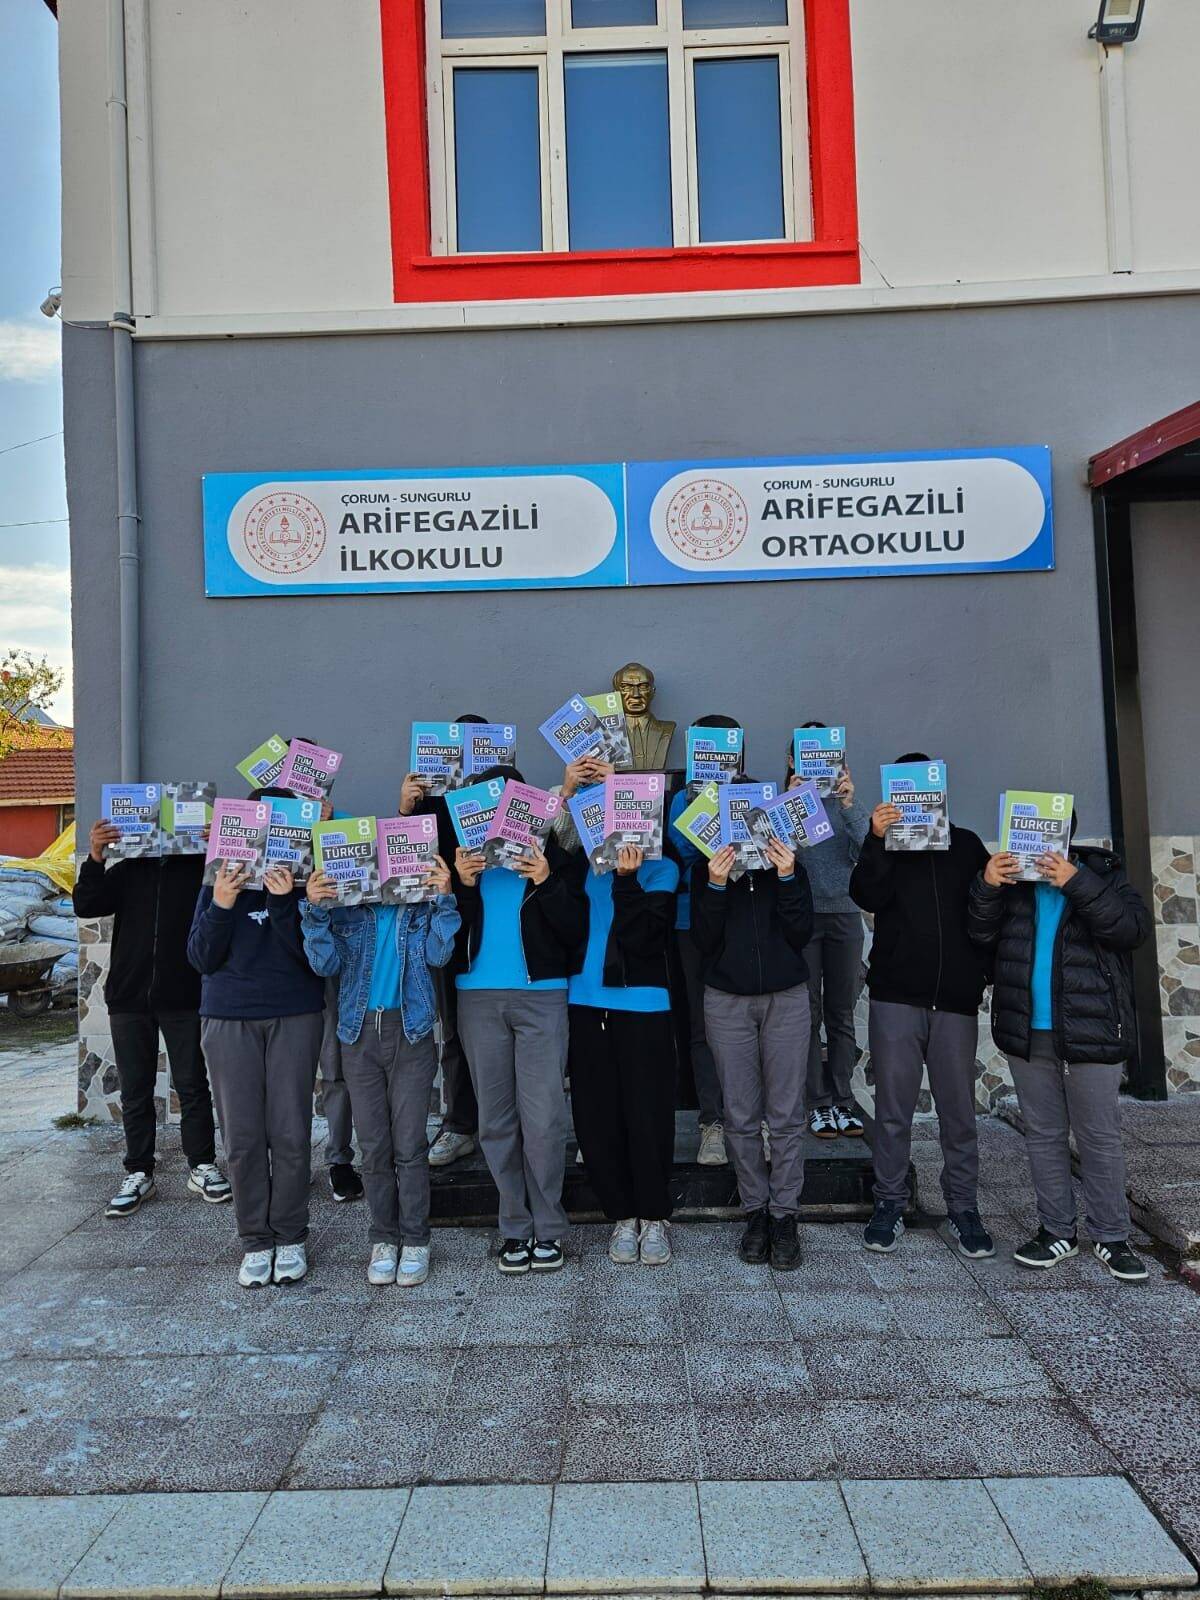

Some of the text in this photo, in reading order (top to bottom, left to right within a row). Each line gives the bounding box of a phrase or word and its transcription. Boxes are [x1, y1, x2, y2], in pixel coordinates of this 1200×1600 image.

[763, 480, 812, 492] ÇORUM
[823, 477, 895, 489] SUNGURLU
[341, 493, 390, 506] ÇORUM
[400, 492, 471, 504] SUNGURLU
[760, 487, 964, 521] ARİFEGAZİLİ
[338, 503, 538, 535] ARİFEGAZİLİ
[761, 530, 965, 558] ORTAOKULU
[340, 545, 503, 572] İLKOKULU
[570, 699, 583, 713] 8
[606, 694, 617, 709] 8
[449, 724, 459, 738] 8
[503, 726, 513, 740] 8
[560, 718, 590, 745] DERSLER
[727, 729, 738, 744] 8
[830, 728, 840, 742] 8
[268, 740, 282, 753] 8
[567, 733, 585, 751] SORU
[474, 747, 507, 755] DERSLER
[327, 753, 338, 767] 8
[695, 763, 716, 771] SORU
[294, 763, 326, 780] DERSLER
[418, 766, 450, 774] BANKASI
[695, 771, 727, 780] BANKASI
[927, 766, 939, 782] 8
[290, 772, 311, 783] SORU
[648, 776, 658, 792] 8
[146, 785, 156, 799] 8
[288, 781, 321, 796] BANKASI
[487, 780, 501, 797] 8
[705, 787, 719, 803] 8
[763, 785, 773, 800] 8
[301, 802, 314, 819] 8
[545, 797, 558, 812] 8
[615, 801, 651, 810] DERSLER
[794, 799, 807, 815] FEN
[901, 805, 917, 813] ORU
[1052, 795, 1065, 812] 8
[113, 807, 150, 815] DERSLER
[255, 804, 266, 820] 8
[615, 811, 637, 819] SORU
[113, 816, 136, 824] SORU
[222, 815, 240, 825] TÜM
[422, 818, 433, 833] 8
[504, 819, 526, 831] SORU
[508, 810, 543, 827] DERSLER
[778, 808, 791, 829] SORU
[901, 815, 931, 823] ANKASI
[1013, 817, 1058, 833] TÜRKÇE
[119, 824, 149, 832] ANKASI
[221, 827, 257, 837] DERSLER
[270, 827, 310, 839] ATEMATİK
[358, 819, 370, 835] 8
[466, 825, 488, 837] SORU
[615, 822, 650, 830] BANKASI
[816, 821, 830, 835] 8
[220, 838, 243, 847] SORU
[268, 839, 285, 847] ORU
[501, 829, 532, 845] BANKAS
[1012, 832, 1037, 841] SORU
[219, 849, 254, 858] BANKASI
[267, 849, 297, 859] ANKASI
[325, 844, 368, 859] TÜRKÇE
[389, 843, 427, 855] DERSLER
[1011, 842, 1050, 852] BANKASI
[326, 862, 350, 871] SORU
[390, 855, 414, 865] SORU
[391, 865, 426, 875] BANKAS
